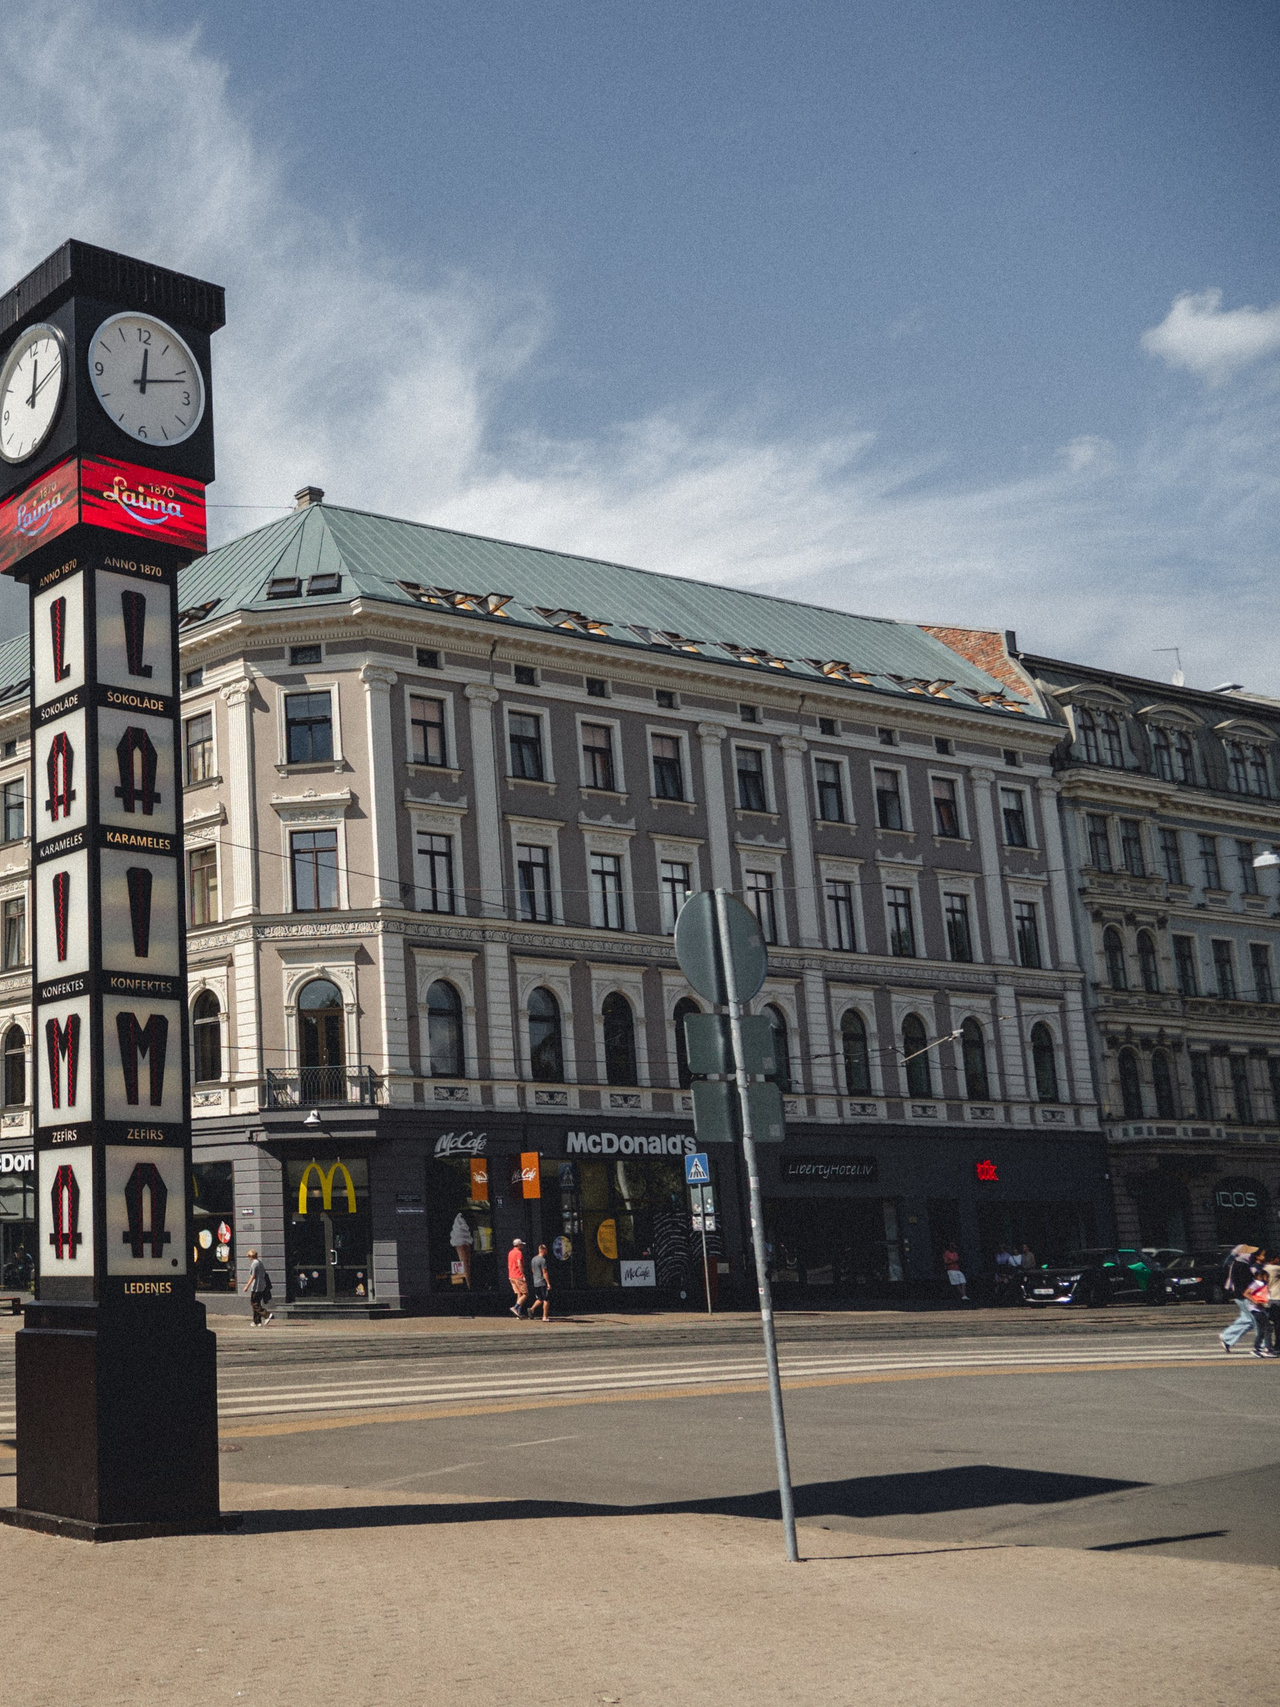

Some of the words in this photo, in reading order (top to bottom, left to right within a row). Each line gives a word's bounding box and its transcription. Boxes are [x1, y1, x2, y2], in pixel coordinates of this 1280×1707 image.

[136, 328, 152, 346] 12
[94, 361, 104, 376] 9
[182, 391, 191, 406] 3
[3, 409, 11, 427] 9
[149, 482, 175, 498] 1870
[103, 476, 185, 525] Laima
[12, 492, 64, 537] Laima
[39, 568, 60, 587] ANNO
[61, 558, 77, 575] 1870
[103, 556, 137, 571] ANNO
[140, 563, 163, 577] 1870
[40, 833, 83, 857] KARAMELES
[106, 831, 171, 850] KARAMELES
[42, 979, 84, 998] KONFEKTES
[110, 977, 172, 993] KONFEKTES
[434, 1132, 487, 1157] McCafé
[566, 1132, 698, 1155] McDonald's
[1215, 1191, 1257, 1209] IQOS
